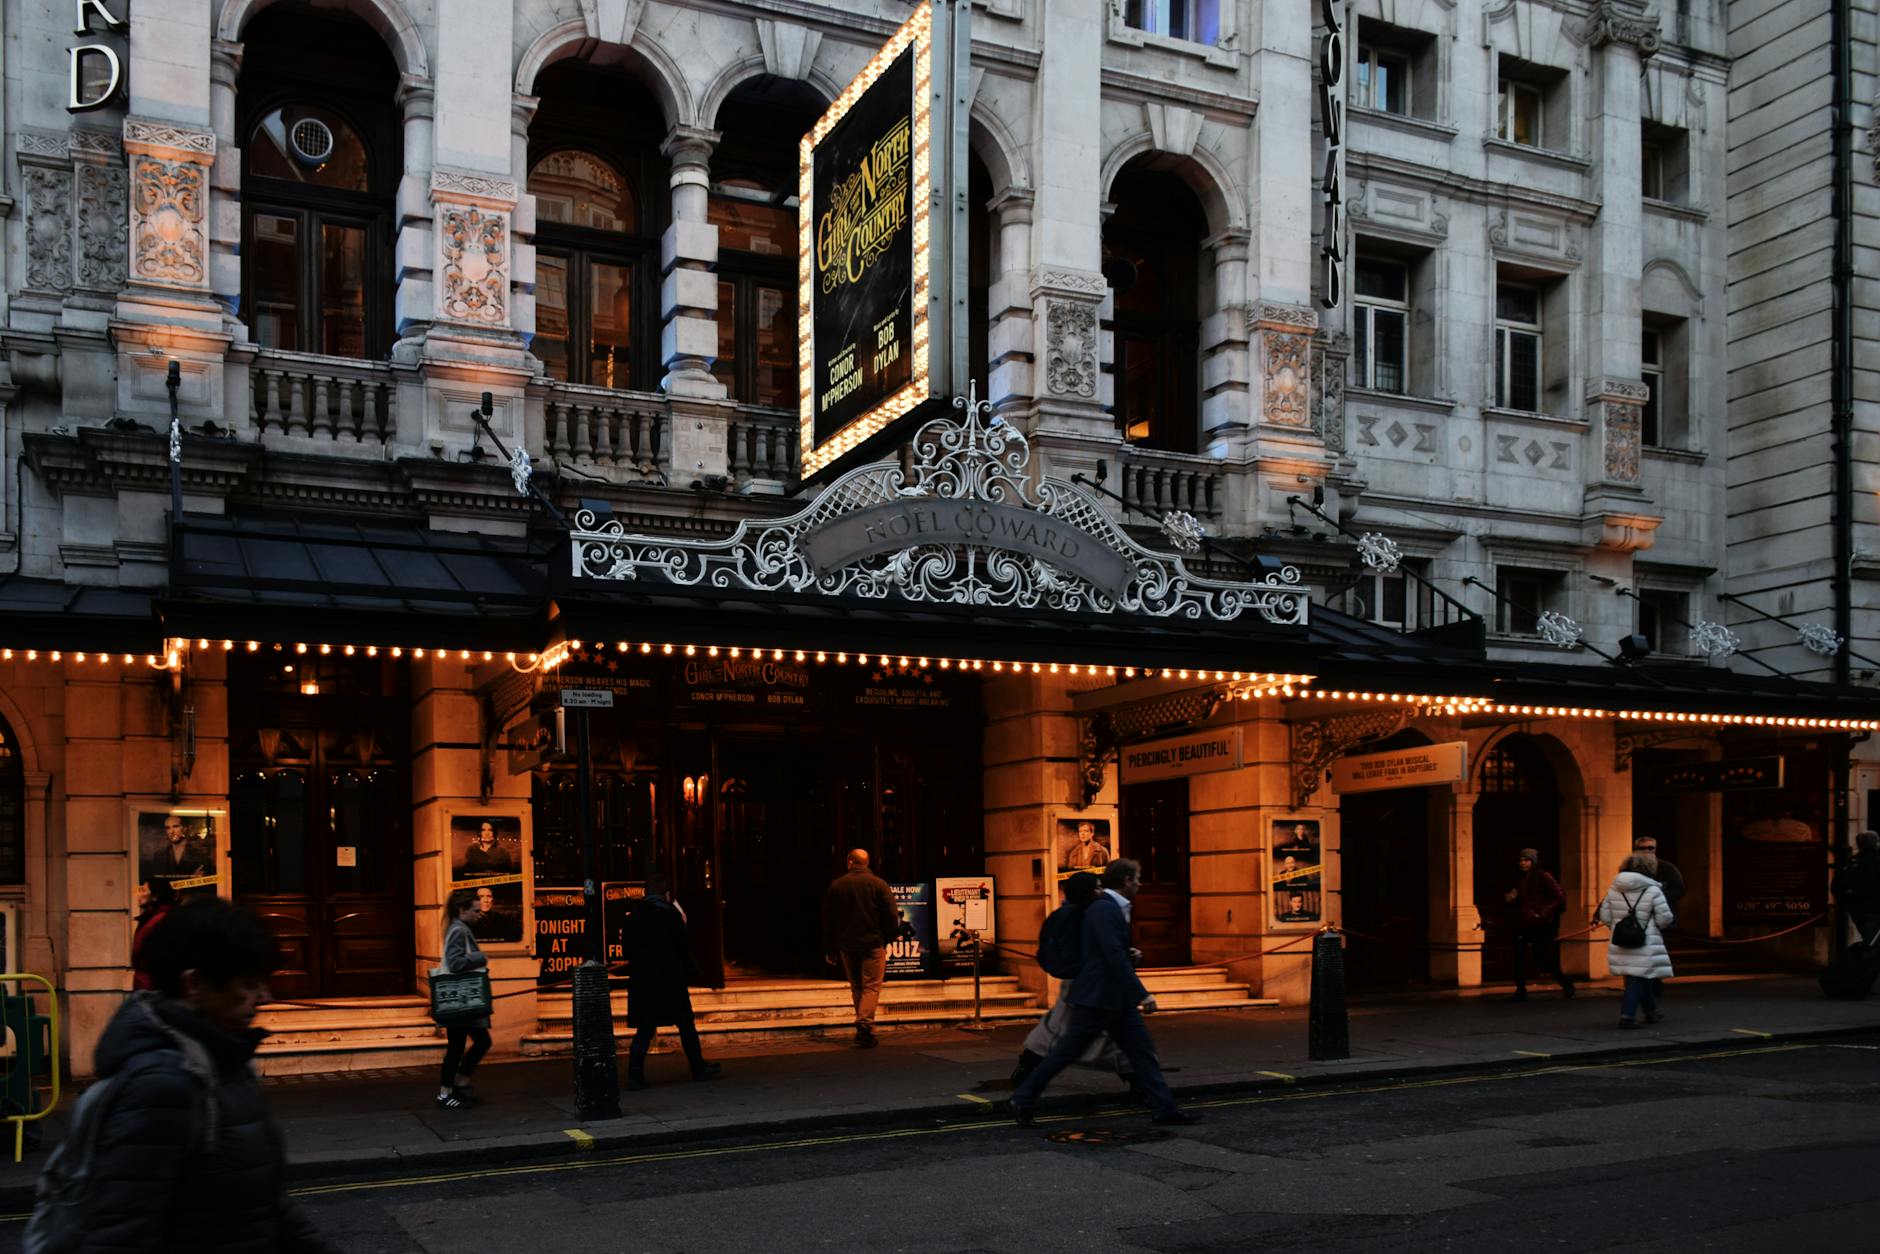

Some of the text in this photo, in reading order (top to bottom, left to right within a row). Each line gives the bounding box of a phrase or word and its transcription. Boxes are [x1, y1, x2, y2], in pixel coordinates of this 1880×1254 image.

[860, 126, 910, 217] NORTH
[846, 188, 907, 283] COUNTRY
[878, 322, 894, 349] BOB
[830, 354, 854, 385] CONOR
[874, 340, 899, 374] DYLAN
[955, 511, 1079, 559] COWARD
[552, 938, 568, 953] AT
